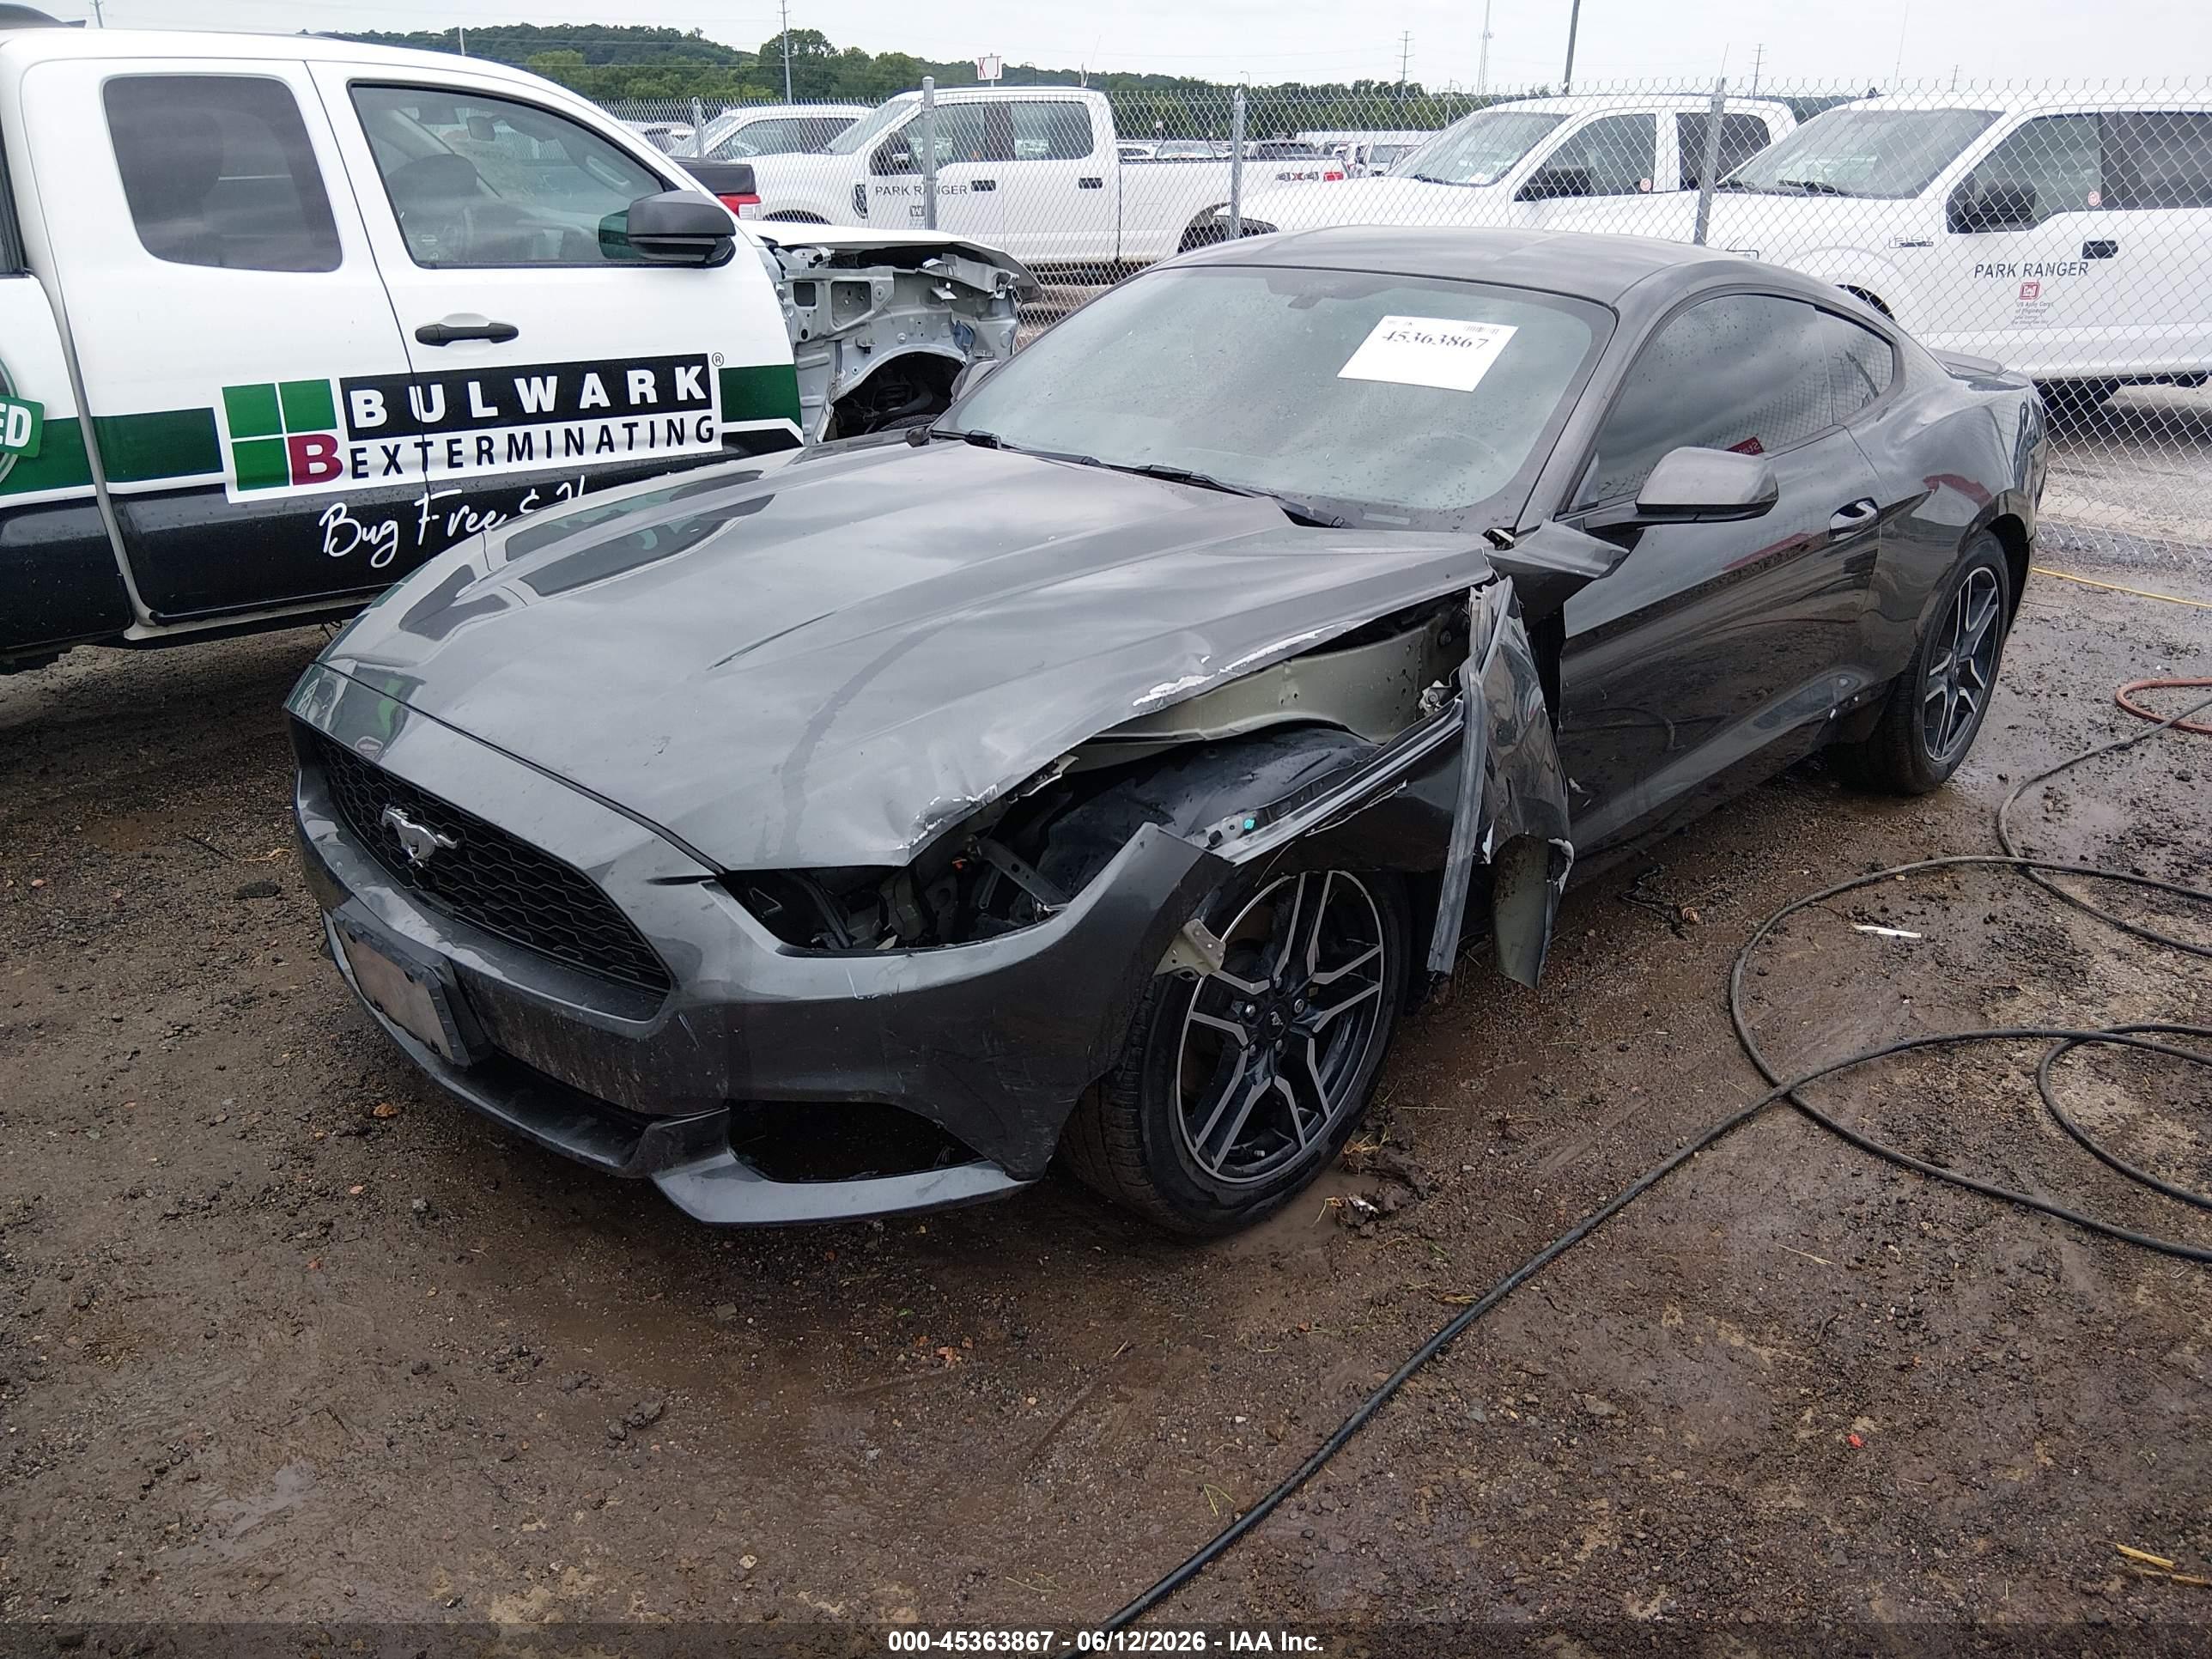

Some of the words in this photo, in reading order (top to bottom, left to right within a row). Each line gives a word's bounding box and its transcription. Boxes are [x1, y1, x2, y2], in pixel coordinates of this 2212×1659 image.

[876, 185, 910, 196] PARK
[1974, 263, 2017, 278] PARK
[2023, 261, 2088, 277] RANGER
[1382, 330, 1489, 349] 45363867
[349, 366, 706, 428] BULWARK
[350, 416, 714, 479] EXTERMINATING
[319, 502, 398, 568] Bug
[414, 489, 507, 546] Free
